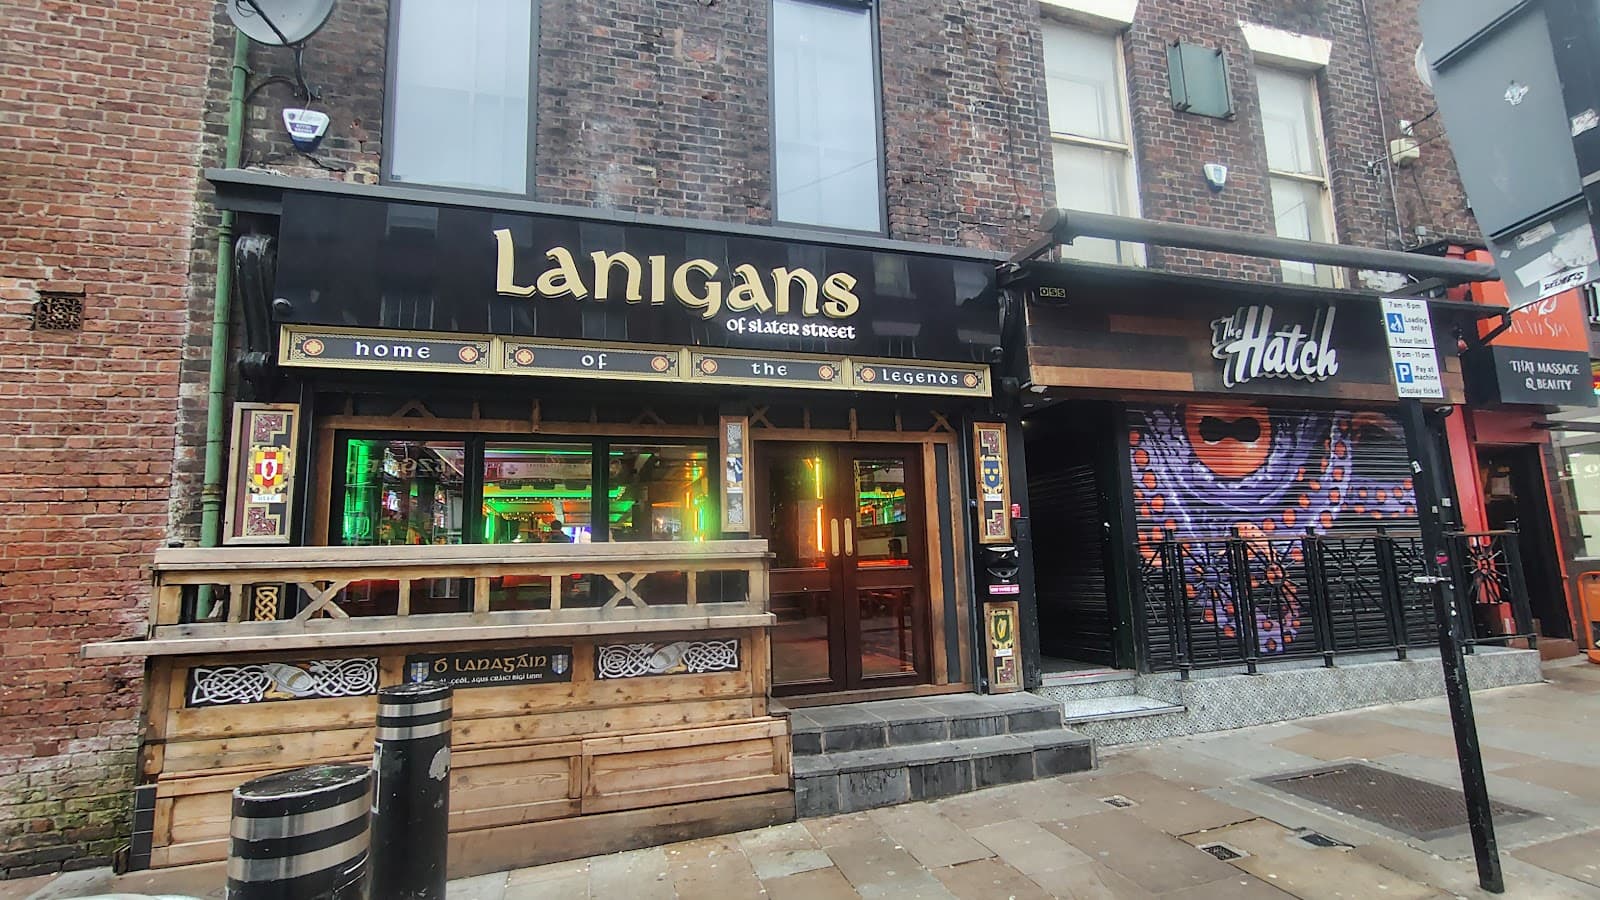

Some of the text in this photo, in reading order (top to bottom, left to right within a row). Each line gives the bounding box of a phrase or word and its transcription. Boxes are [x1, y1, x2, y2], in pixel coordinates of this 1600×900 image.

[1405, 316, 1427, 325] Loading
[1221, 304, 1339, 384] The Hatch
[581, 354, 607, 369] of
[751, 362, 788, 376] the
[1415, 365, 1426, 373] Pay
[1509, 360, 1580, 375] THAI MASSAGE
[1400, 387, 1422, 395] Display
[1537, 379, 1572, 391] BEAUTY
